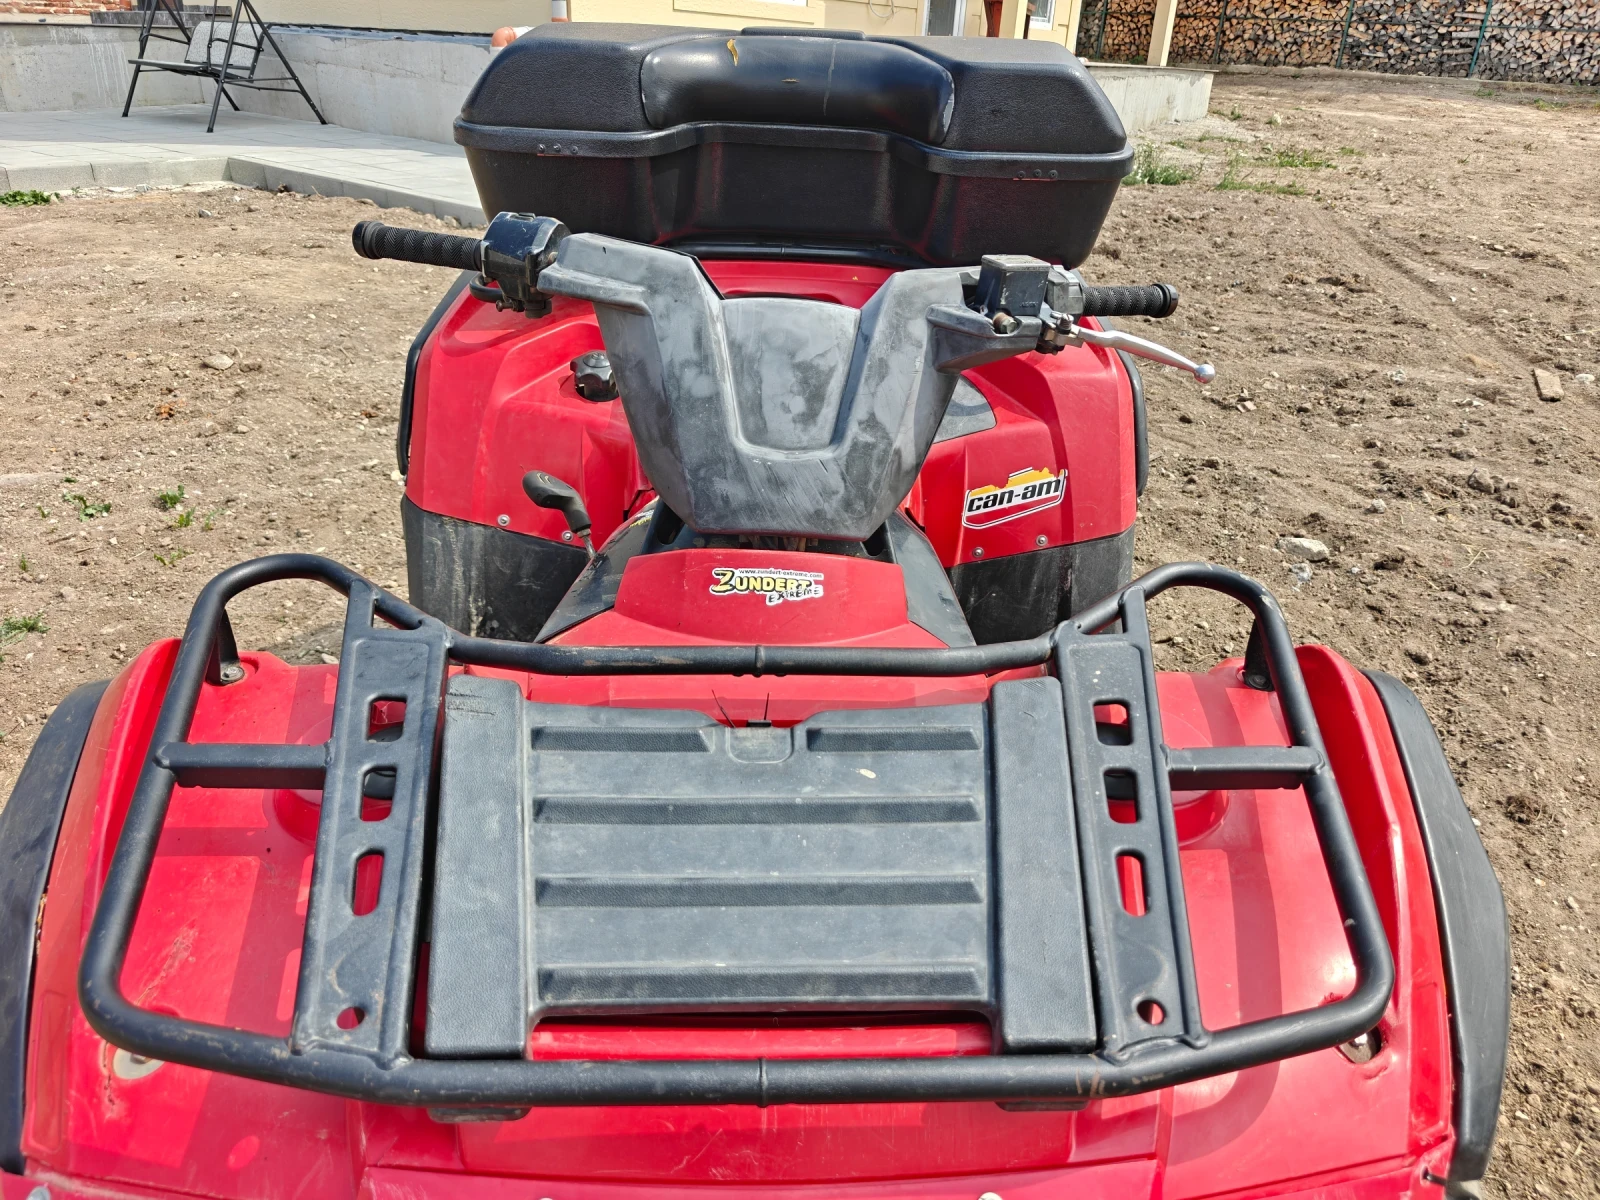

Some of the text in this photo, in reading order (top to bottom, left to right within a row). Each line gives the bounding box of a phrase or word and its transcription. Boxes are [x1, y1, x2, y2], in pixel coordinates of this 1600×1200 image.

[967, 479, 1061, 512] can-am
[711, 569, 812, 593] ZUNDERT
[739, 569, 822, 578] www.zundert-extreme.com
[768, 587, 820, 603] EXTREME
